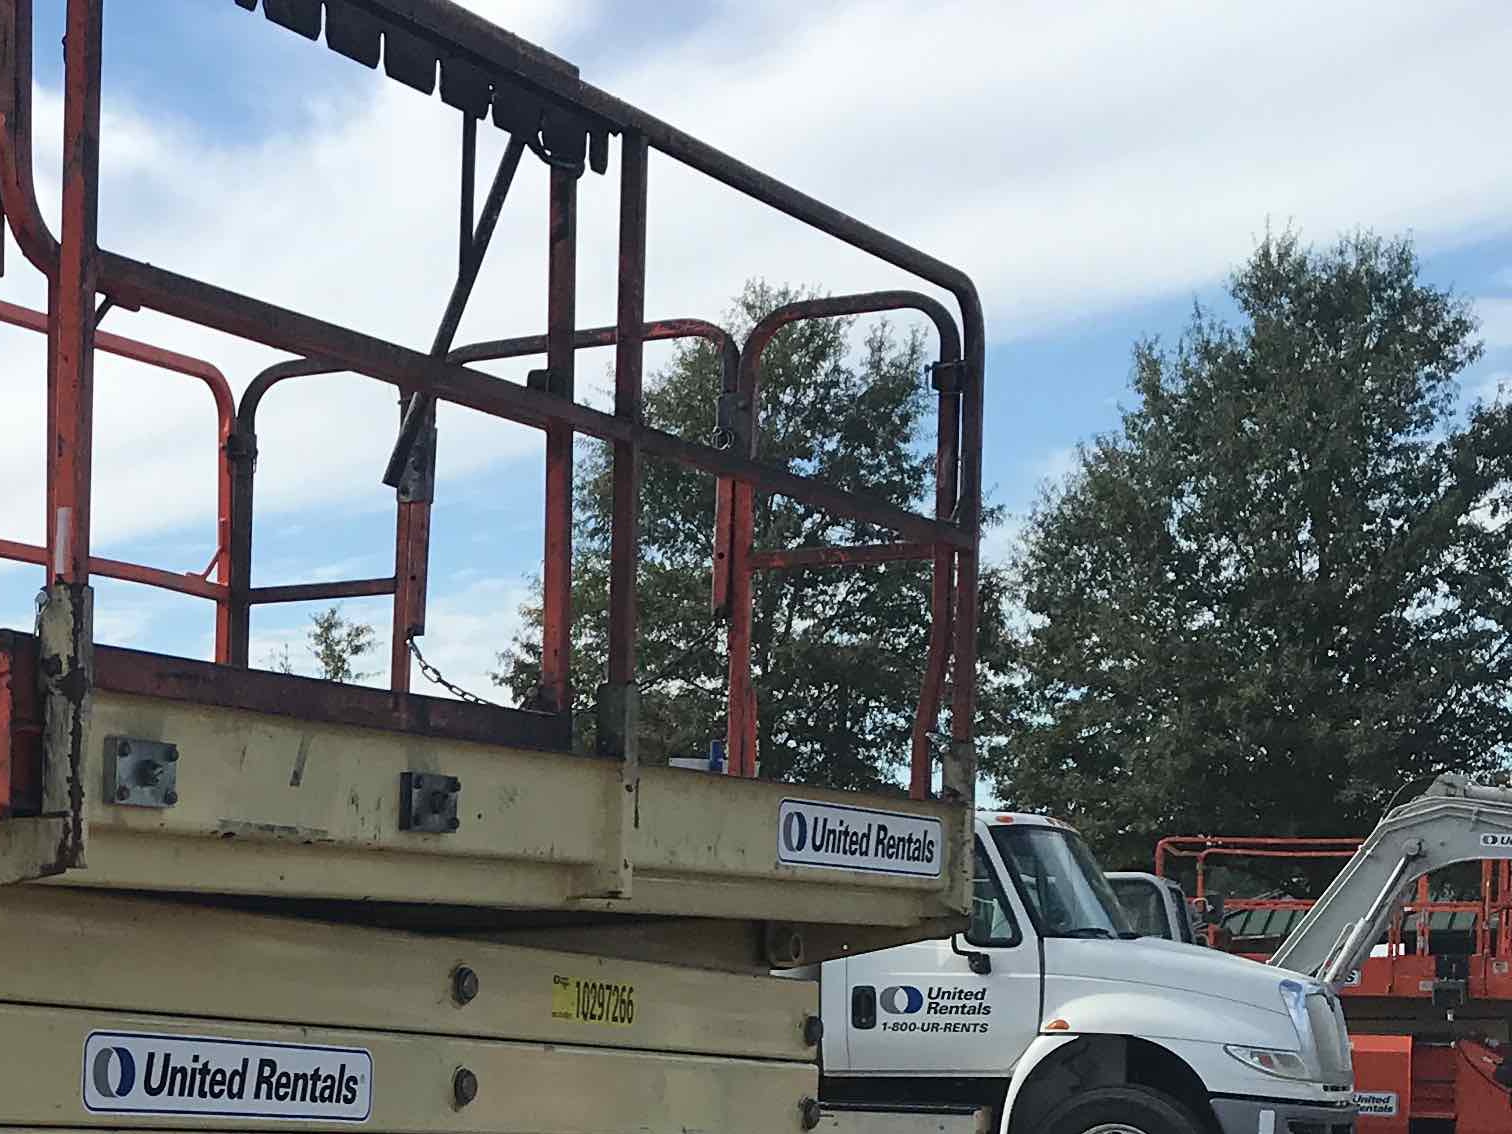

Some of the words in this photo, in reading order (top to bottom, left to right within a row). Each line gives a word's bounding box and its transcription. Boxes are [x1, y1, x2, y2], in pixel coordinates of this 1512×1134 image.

[812, 816, 872, 856] United
[874, 824, 934, 864] Rentals
[928, 987, 986, 1001] United
[576, 981, 634, 1023] 10297266
[927, 1002, 991, 1015] Rentals
[882, 1022, 988, 1033] 1-800-UR-RENTS
[144, 1052, 248, 1099] United
[254, 1058, 359, 1104] Rentals
[1353, 1104, 1393, 1113] entals
